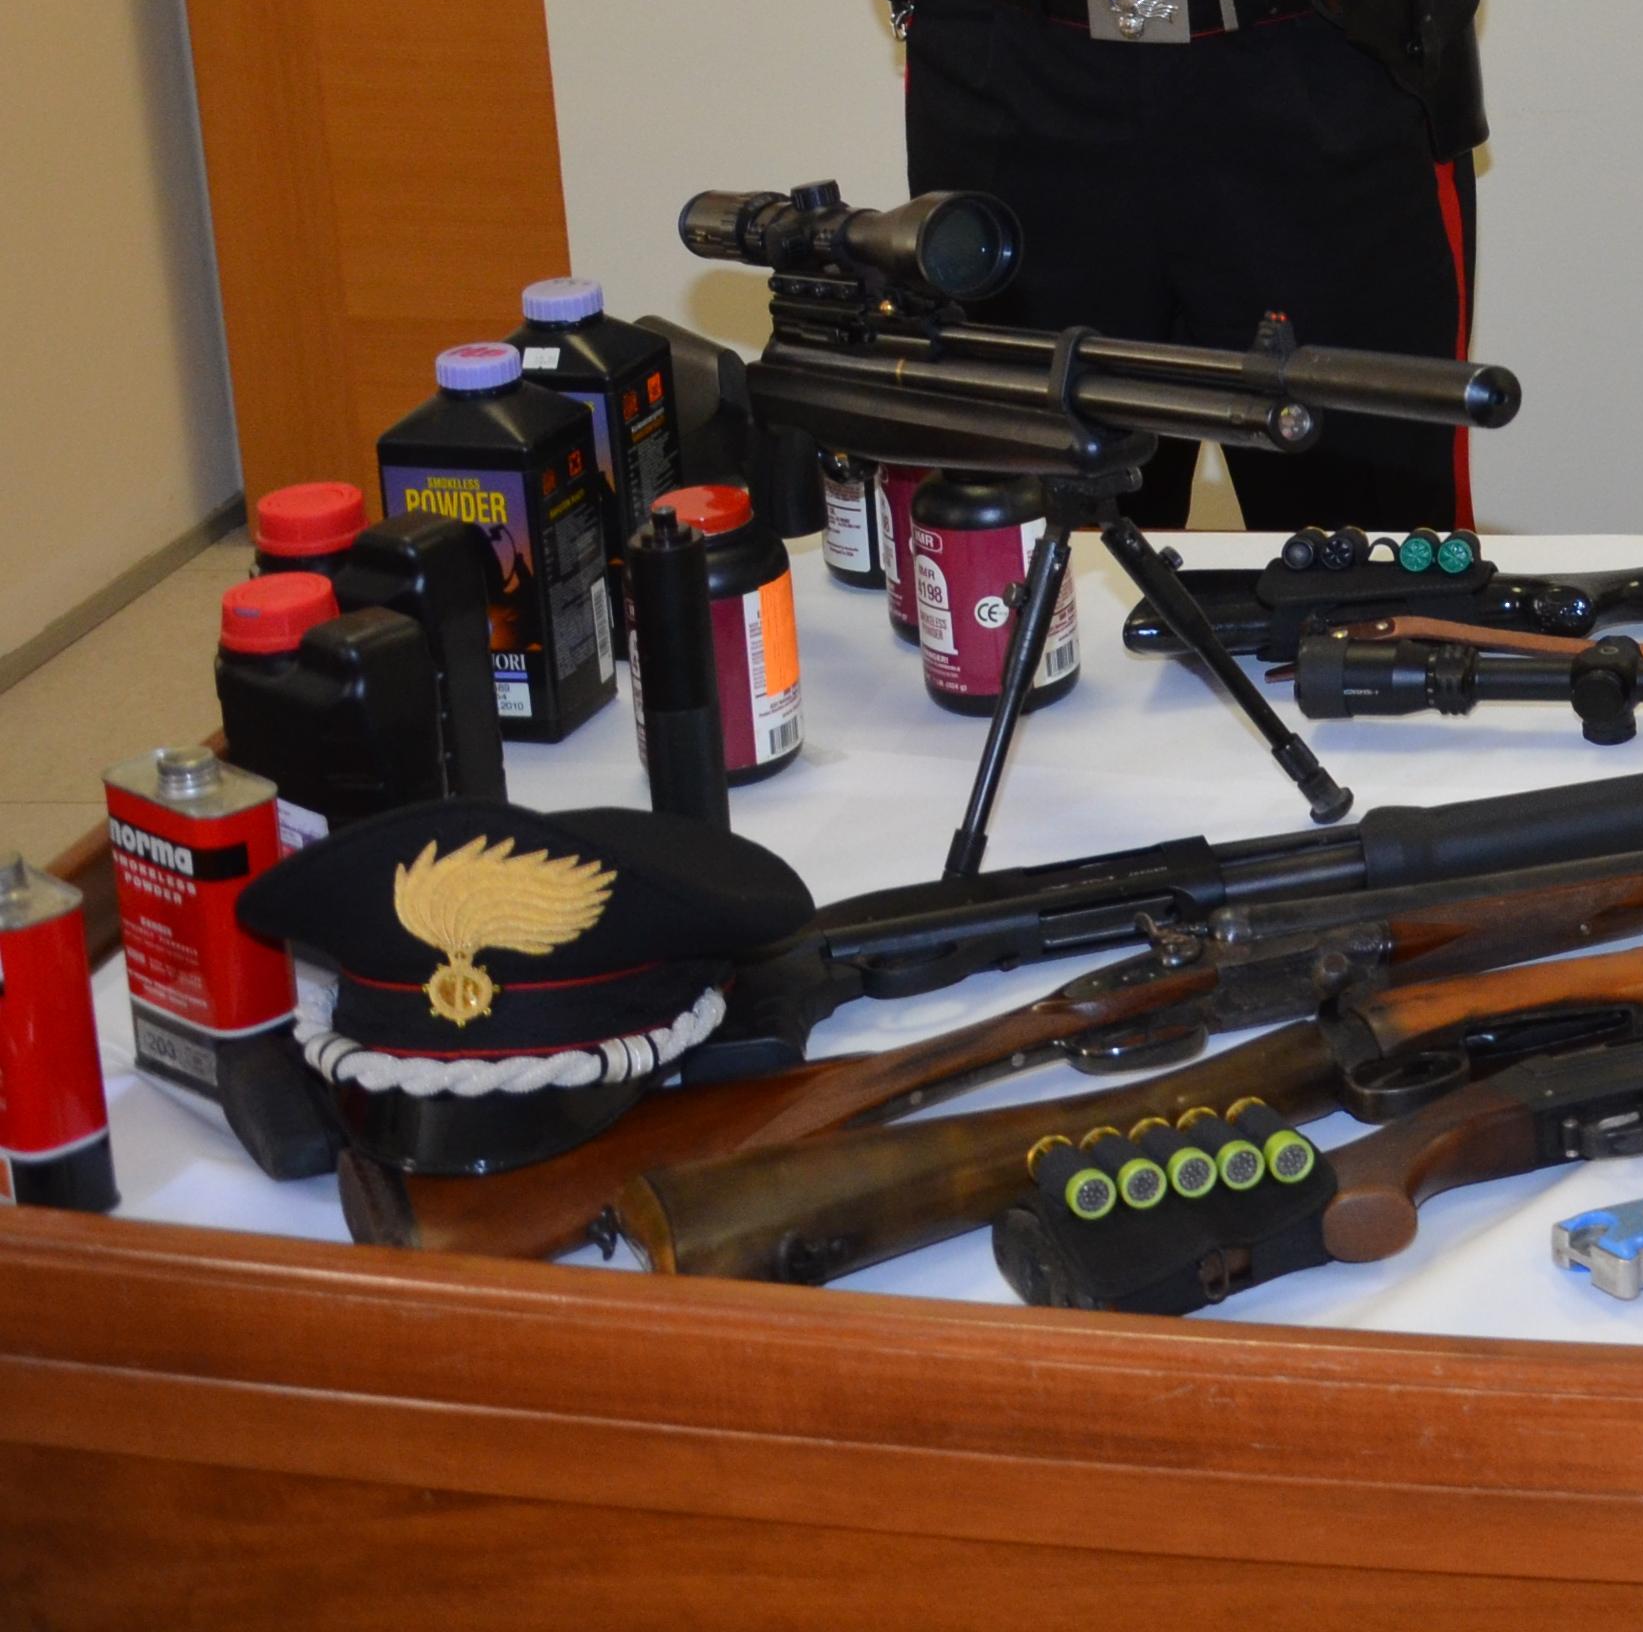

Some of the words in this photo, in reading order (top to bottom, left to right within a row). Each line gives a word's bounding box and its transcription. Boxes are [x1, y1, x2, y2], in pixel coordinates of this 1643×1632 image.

[405, 488, 508, 524] POWDER
[915, 529, 934, 548] IMR
[919, 580, 943, 604] 4198
[110, 817, 194, 876] norma
